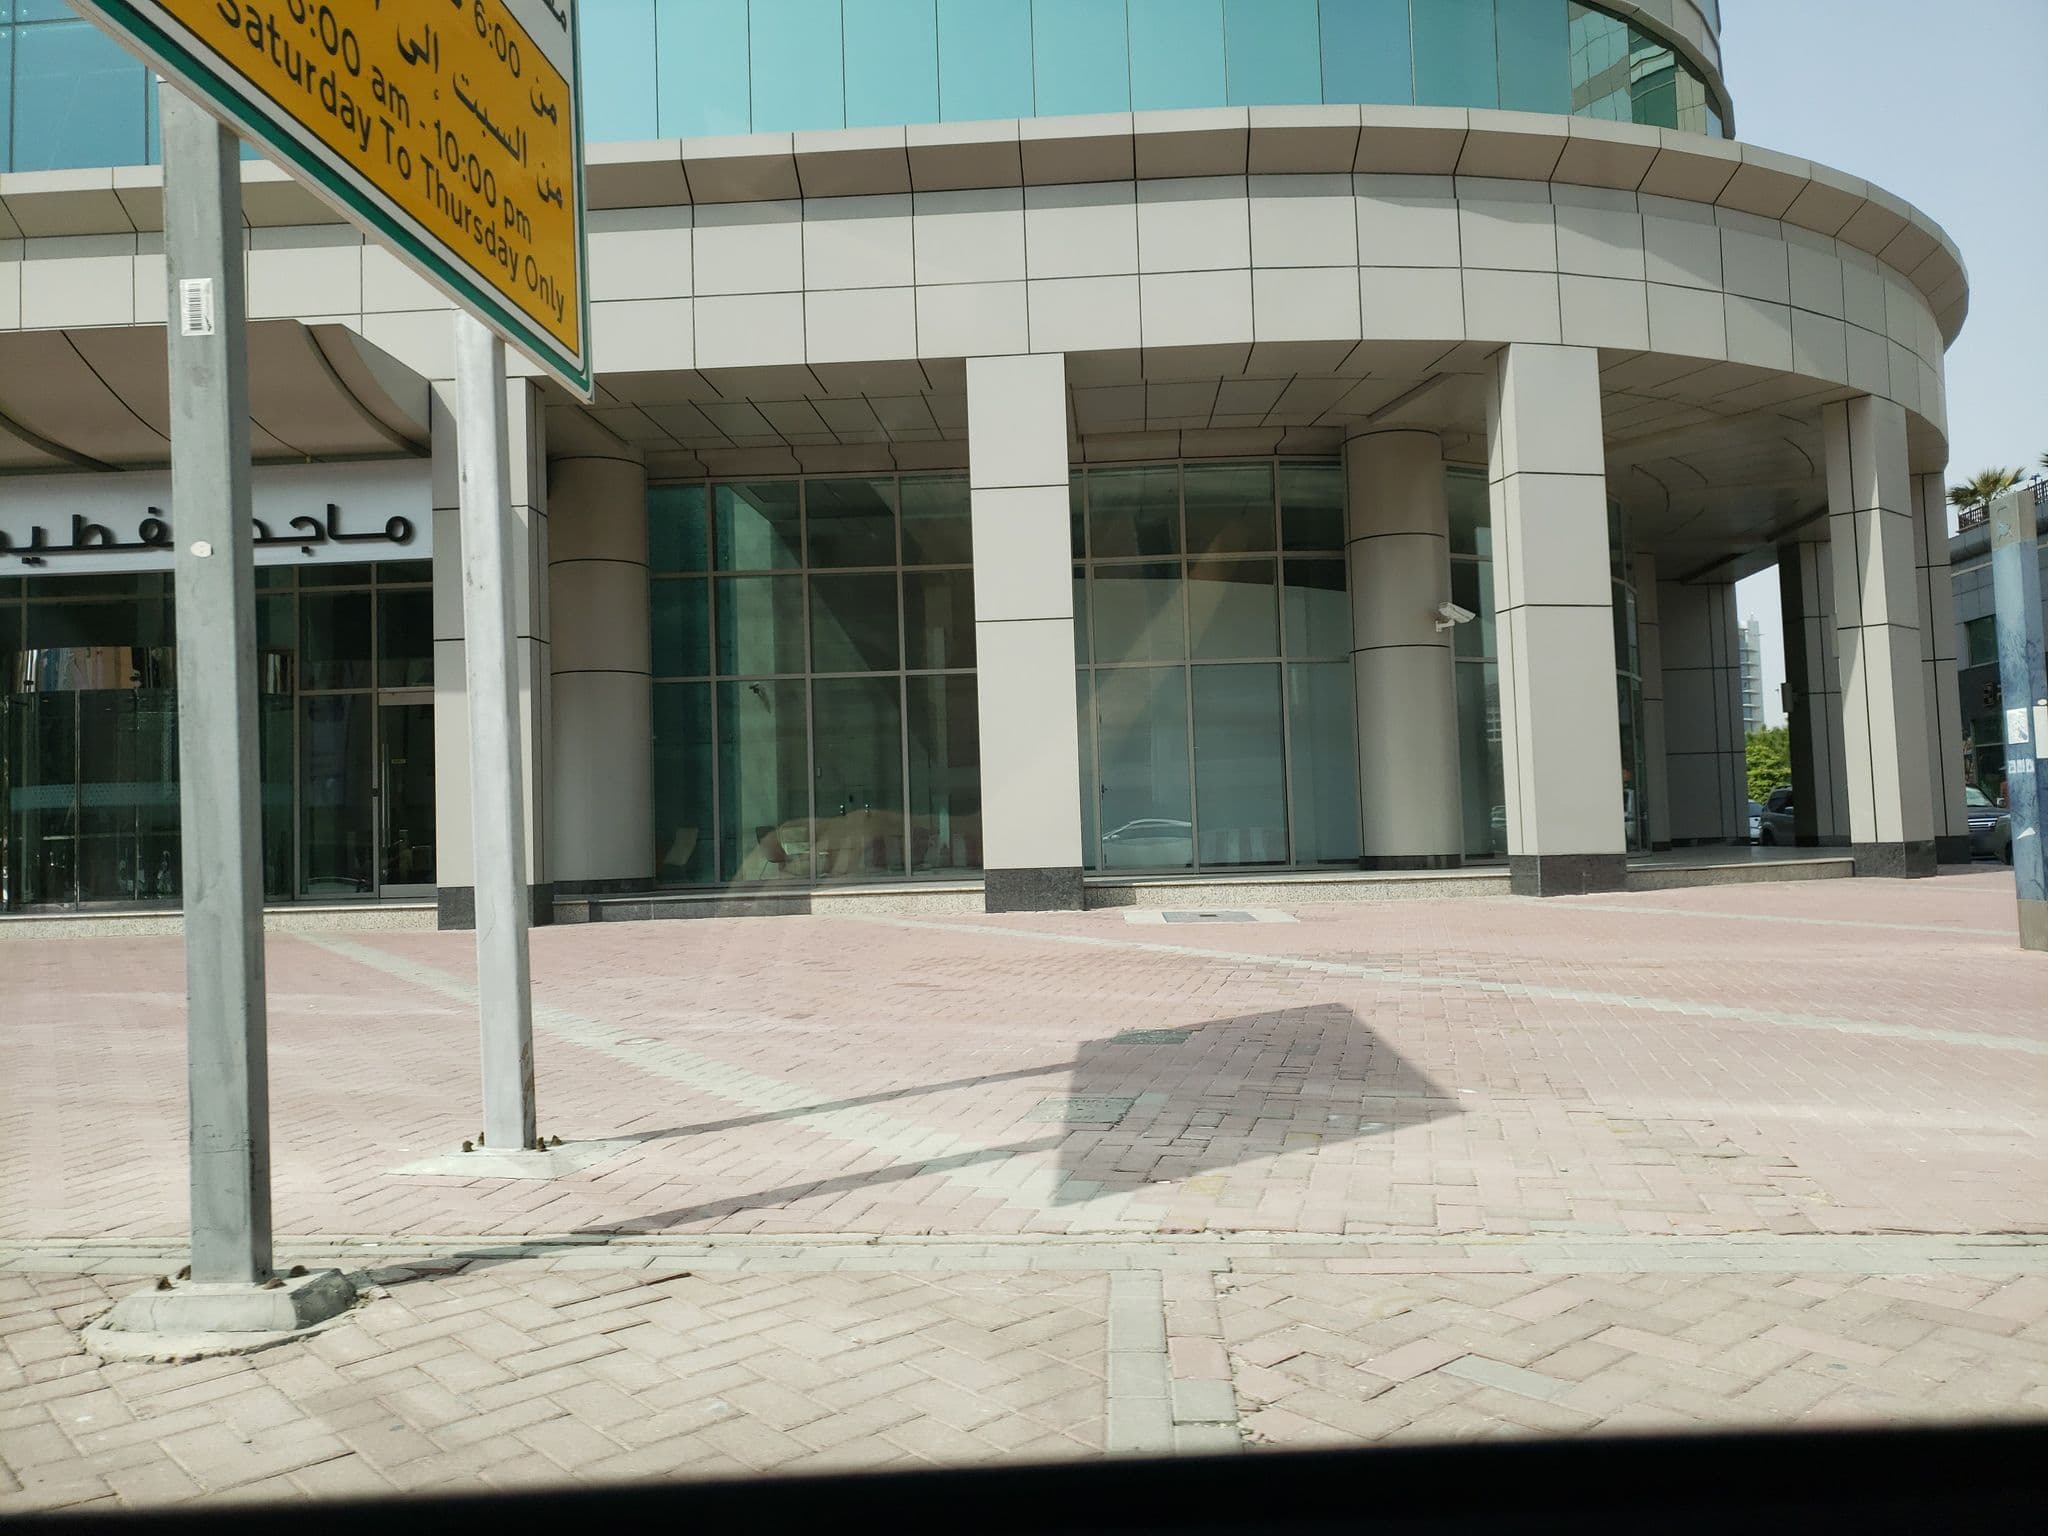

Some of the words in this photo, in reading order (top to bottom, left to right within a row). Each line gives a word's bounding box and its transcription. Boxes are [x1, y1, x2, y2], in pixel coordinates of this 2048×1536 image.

[474, 0, 521, 78] 6:00
[453, 72, 526, 168] السبت
[530, 77, 557, 126] من
[371, 65, 410, 128] am
[434, 120, 496, 208] 10:00
[504, 196, 532, 244] pm
[537, 162, 562, 209] من
[379, 116, 411, 180] To
[420, 154, 518, 281] Thursday
[525, 255, 565, 323] Only
